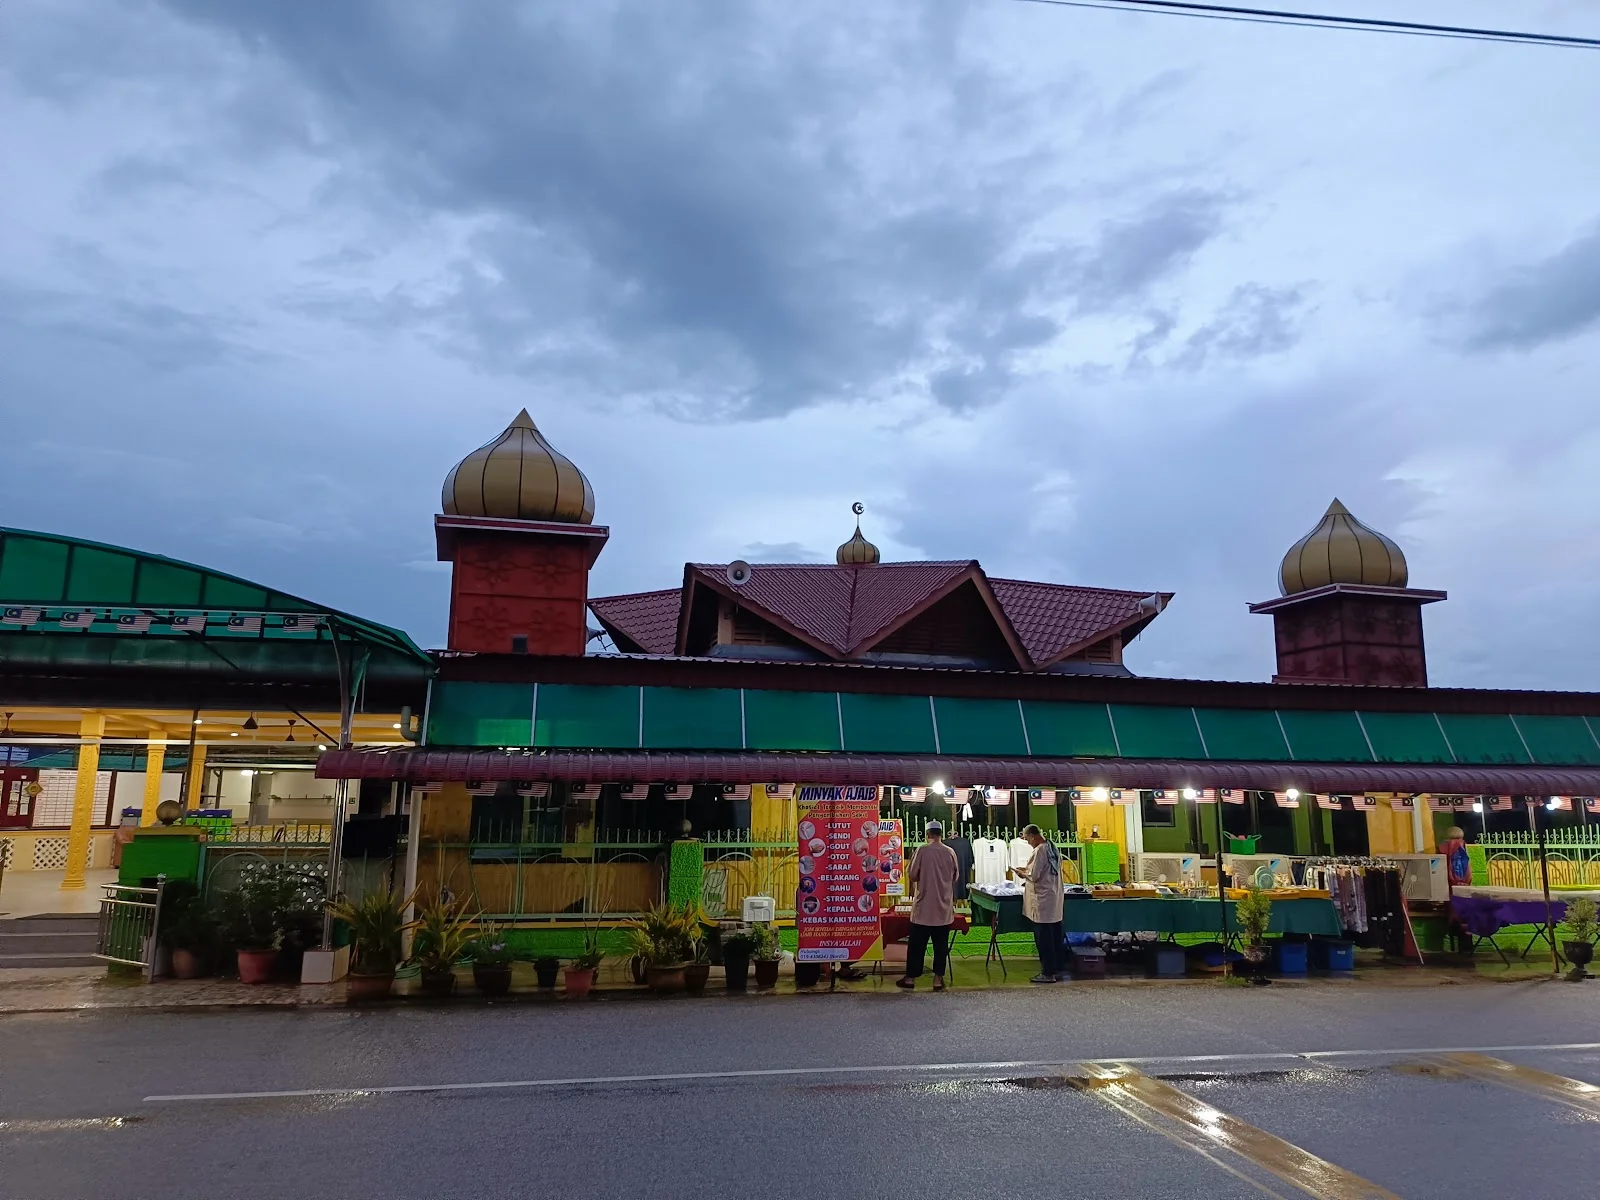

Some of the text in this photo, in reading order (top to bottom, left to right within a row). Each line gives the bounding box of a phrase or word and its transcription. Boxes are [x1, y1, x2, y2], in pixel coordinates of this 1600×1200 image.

[799, 786, 876, 801] MINYAK AJAIB
[879, 822, 894, 831] JAIB
